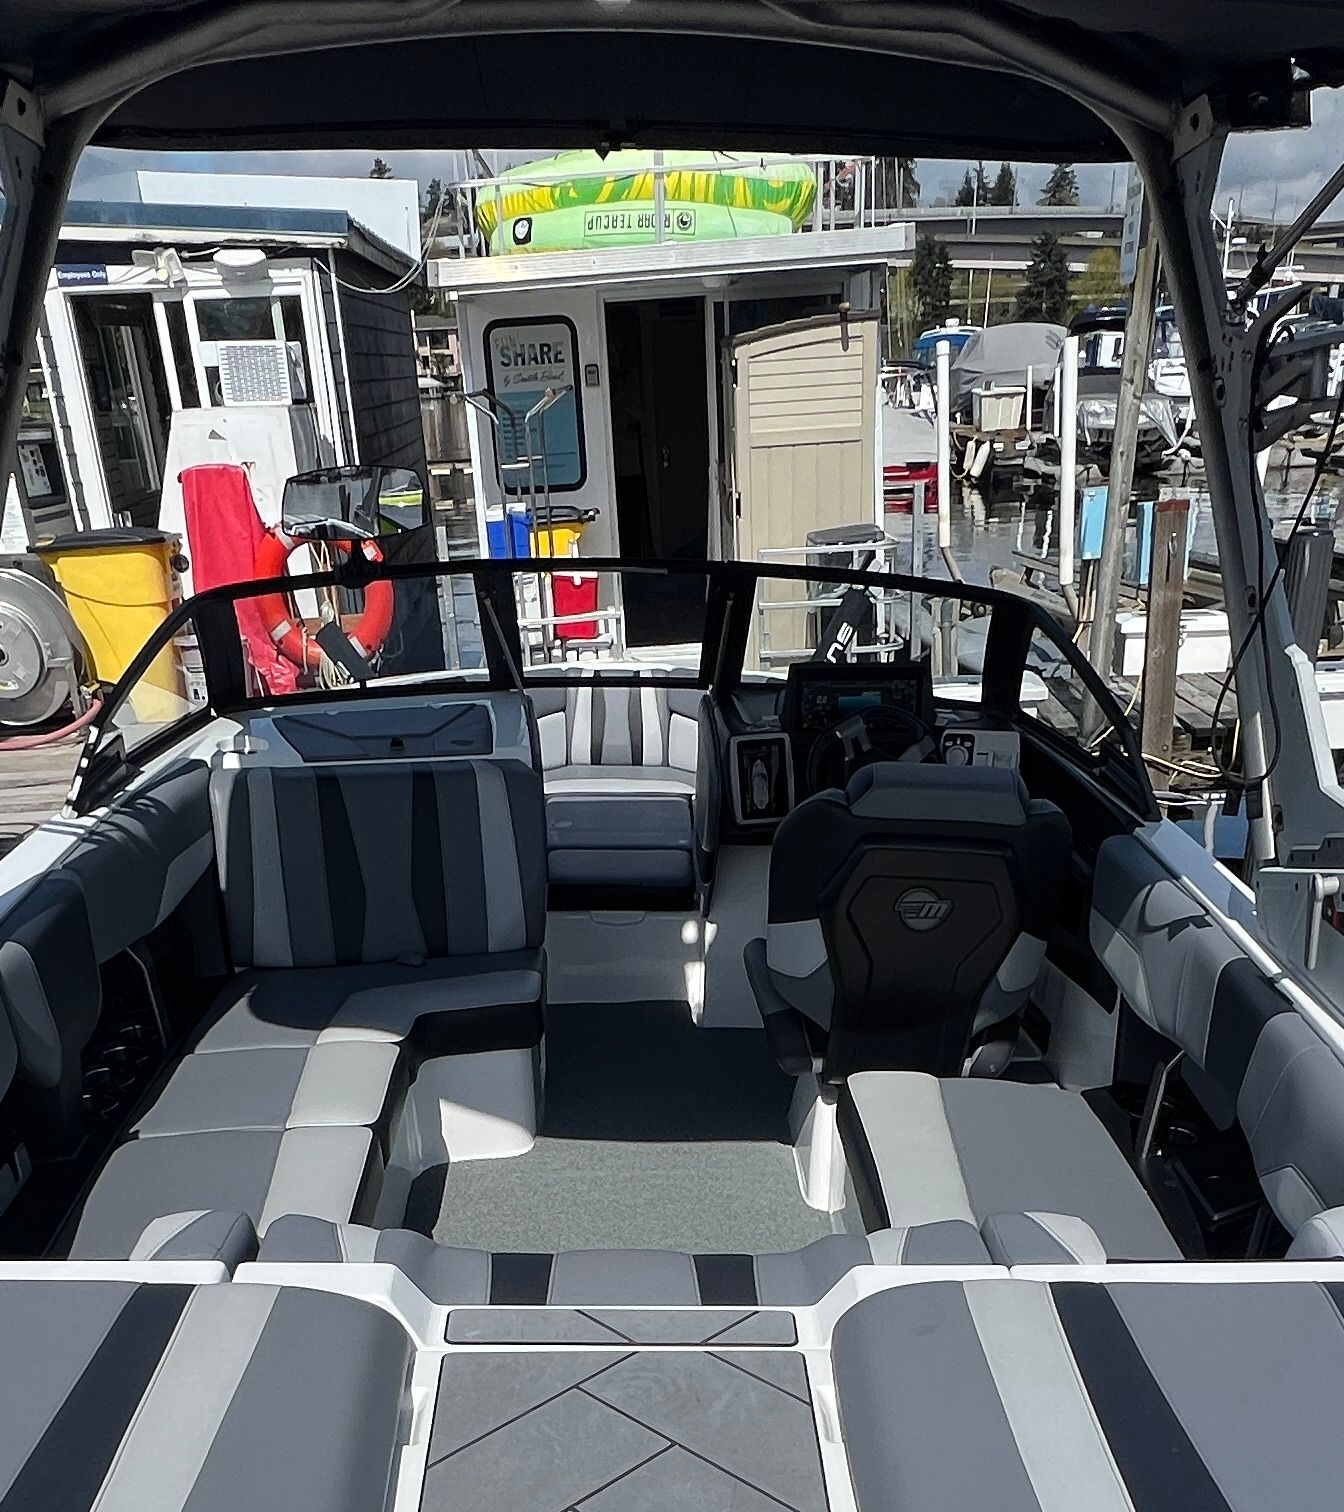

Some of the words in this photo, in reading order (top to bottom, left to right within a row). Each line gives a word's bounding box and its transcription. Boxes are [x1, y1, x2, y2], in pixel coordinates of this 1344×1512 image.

[587, 213, 633, 231] TEACUP
[637, 213, 671, 229] RDAR
[57, 270, 91, 280] Employees
[499, 341, 565, 368] SHARE
